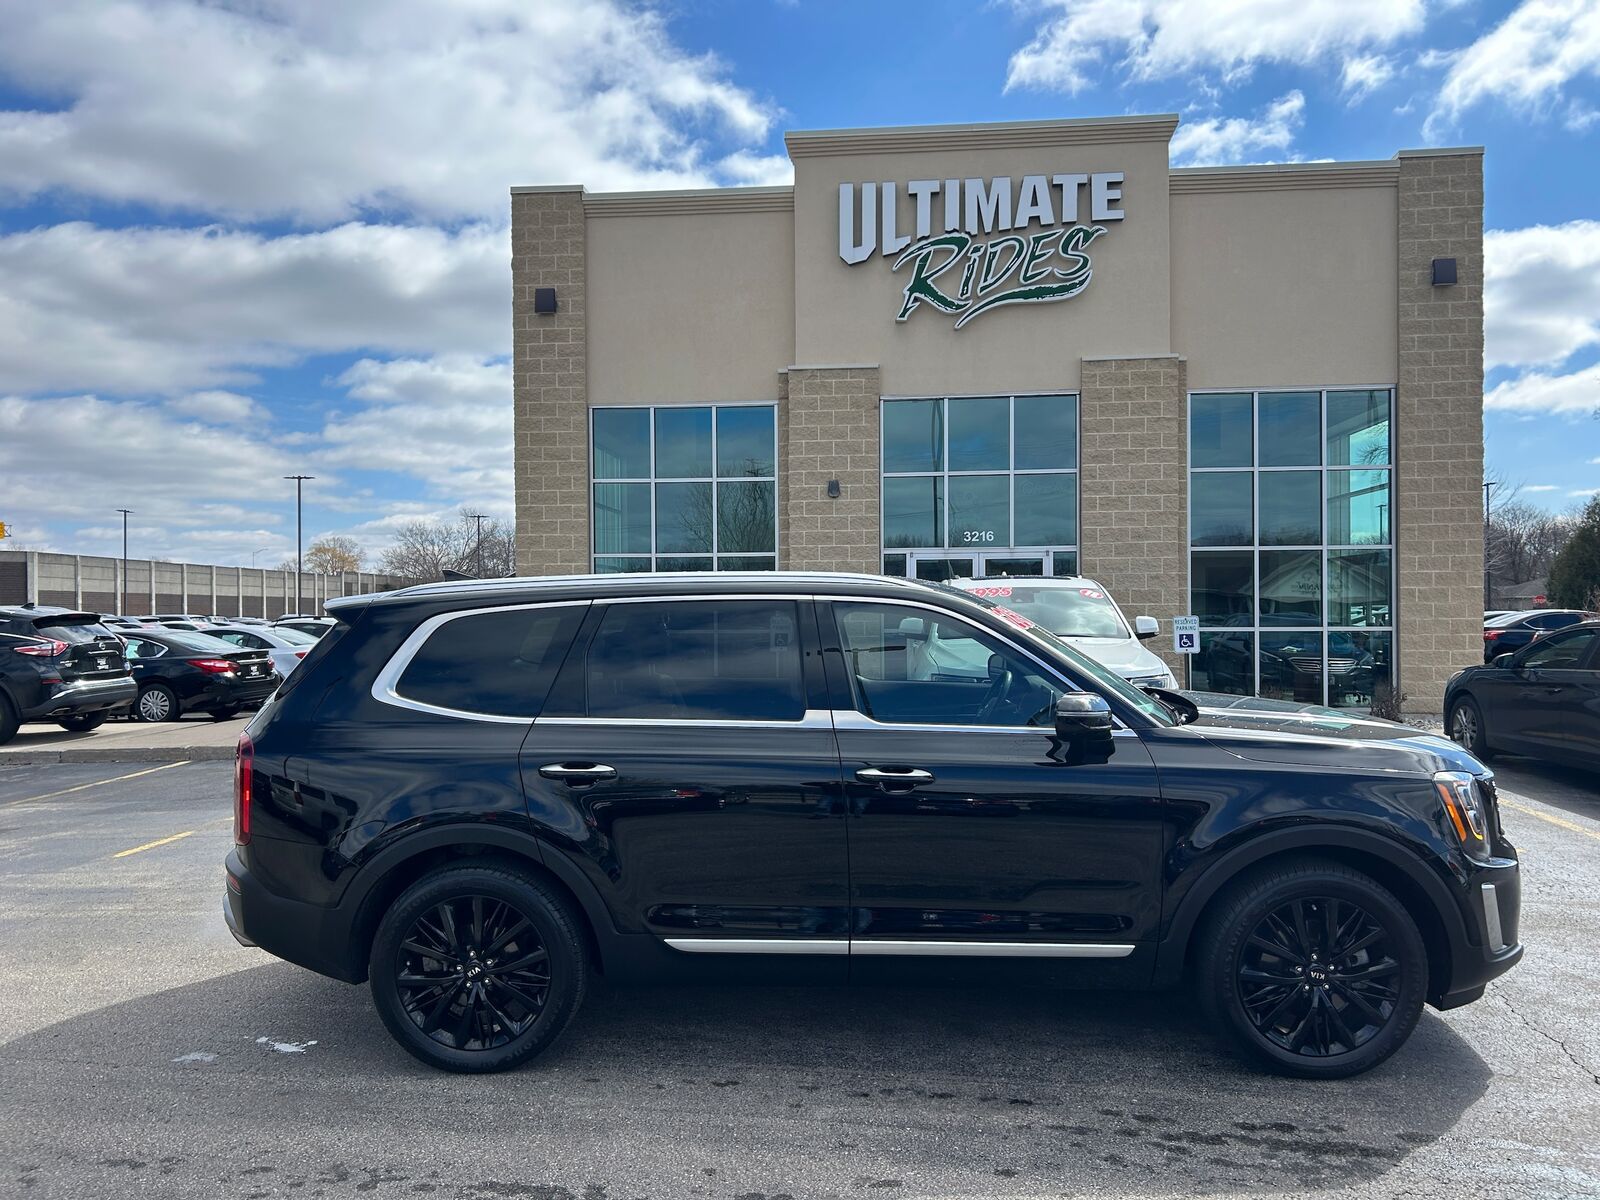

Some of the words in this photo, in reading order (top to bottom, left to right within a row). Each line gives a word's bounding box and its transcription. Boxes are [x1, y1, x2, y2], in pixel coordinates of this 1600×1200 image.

[838, 171, 1126, 266] ULTIMATE
[963, 531, 995, 542] 3216
[467, 966, 481, 978] KIA
[1310, 971, 1325, 980] KIA
